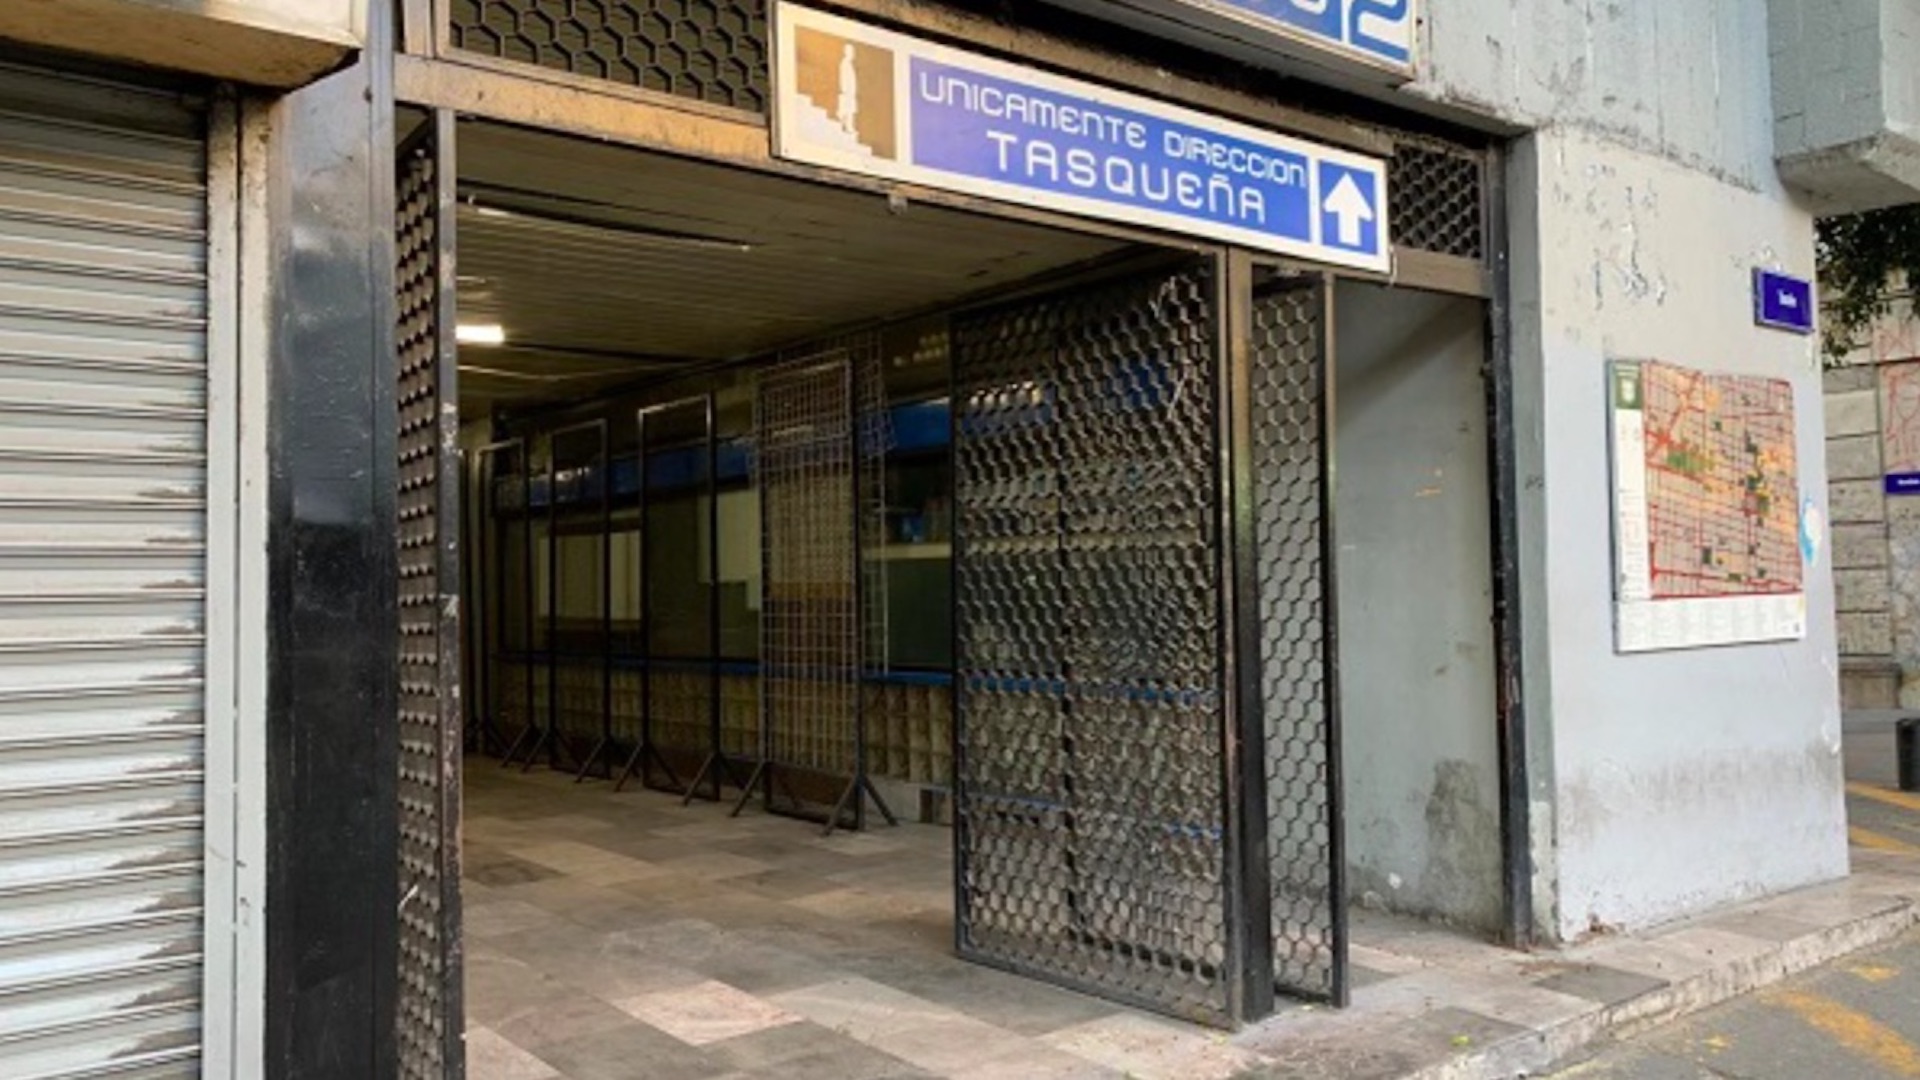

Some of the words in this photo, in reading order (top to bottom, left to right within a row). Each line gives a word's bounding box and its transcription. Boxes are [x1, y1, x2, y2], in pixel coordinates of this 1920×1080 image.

[920, 71, 1147, 149] UNICAMENTE
[1163, 129, 1306, 188] DIRECCION
[986, 129, 1265, 224] TASQUEÑA
